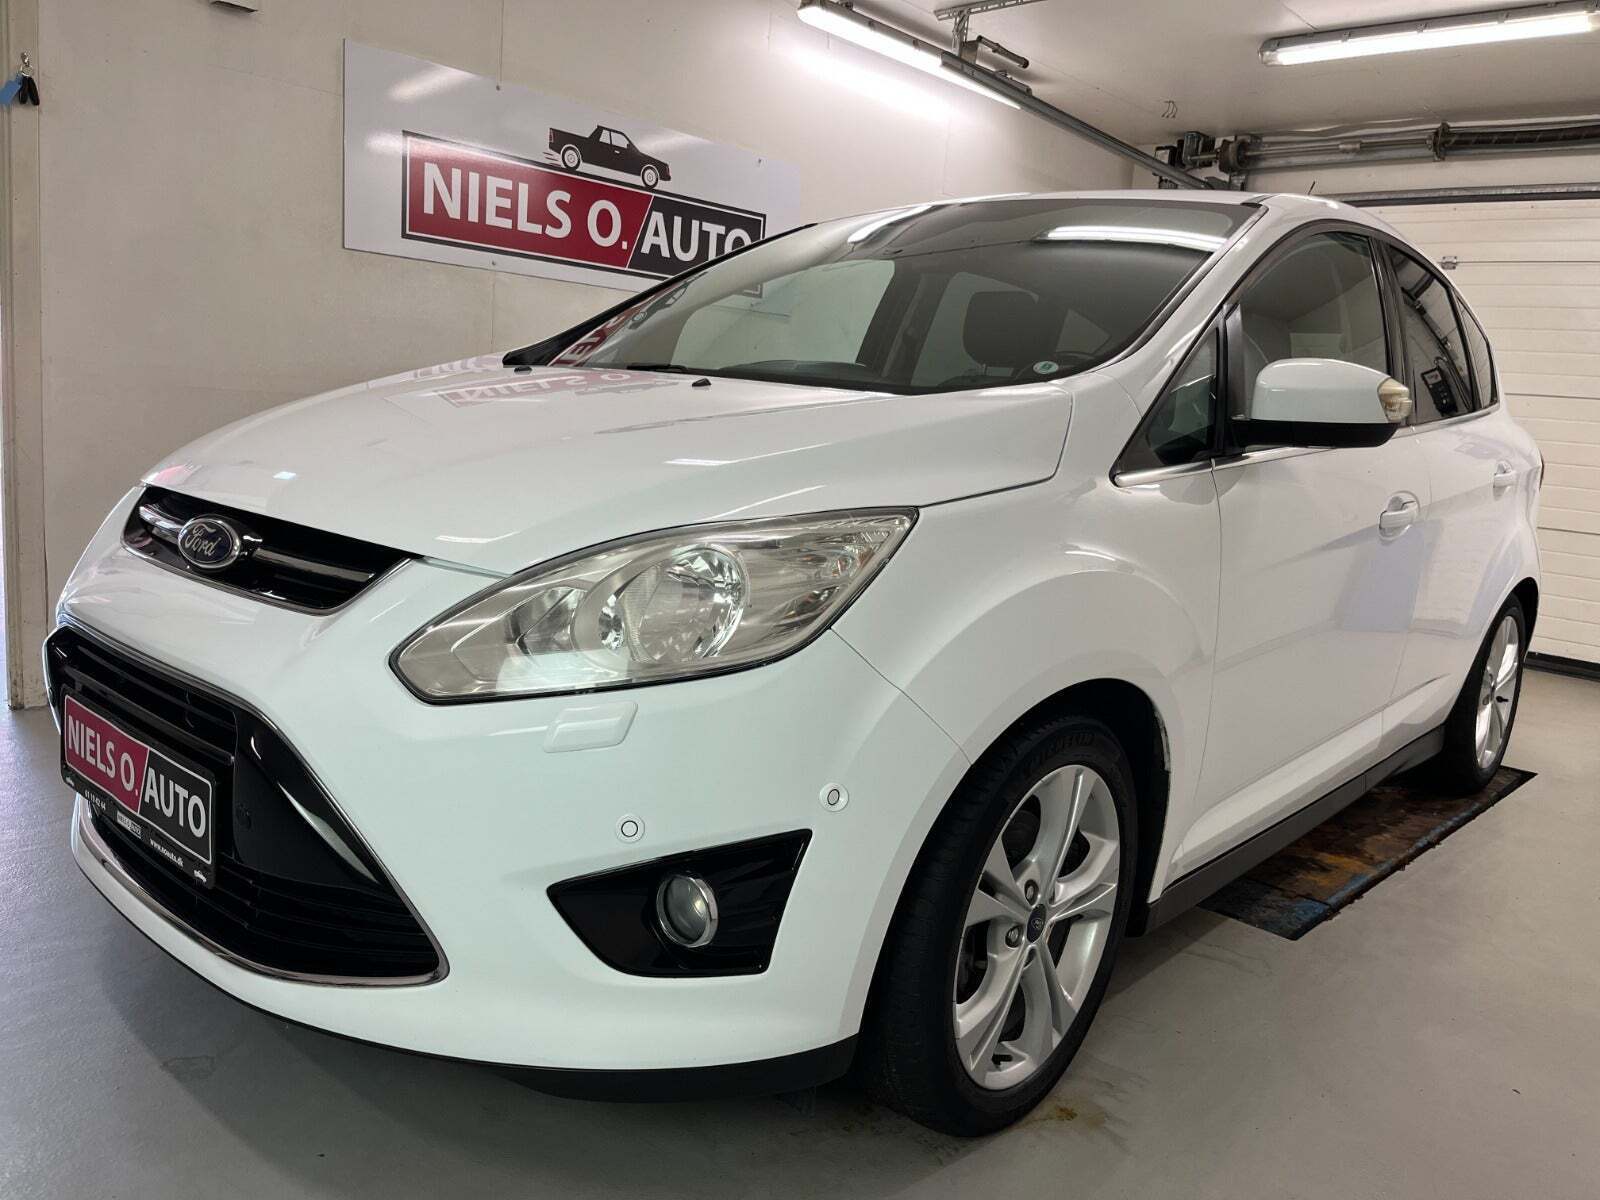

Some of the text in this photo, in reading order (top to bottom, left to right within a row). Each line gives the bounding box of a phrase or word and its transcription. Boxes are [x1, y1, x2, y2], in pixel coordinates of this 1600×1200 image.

[424, 162, 572, 239] NIELS
[587, 199, 628, 250] O.
[184, 523, 222, 557] Ford
[68, 714, 116, 779] NIELS
[120, 752, 139, 797] O.
[144, 767, 206, 838] AUTO
